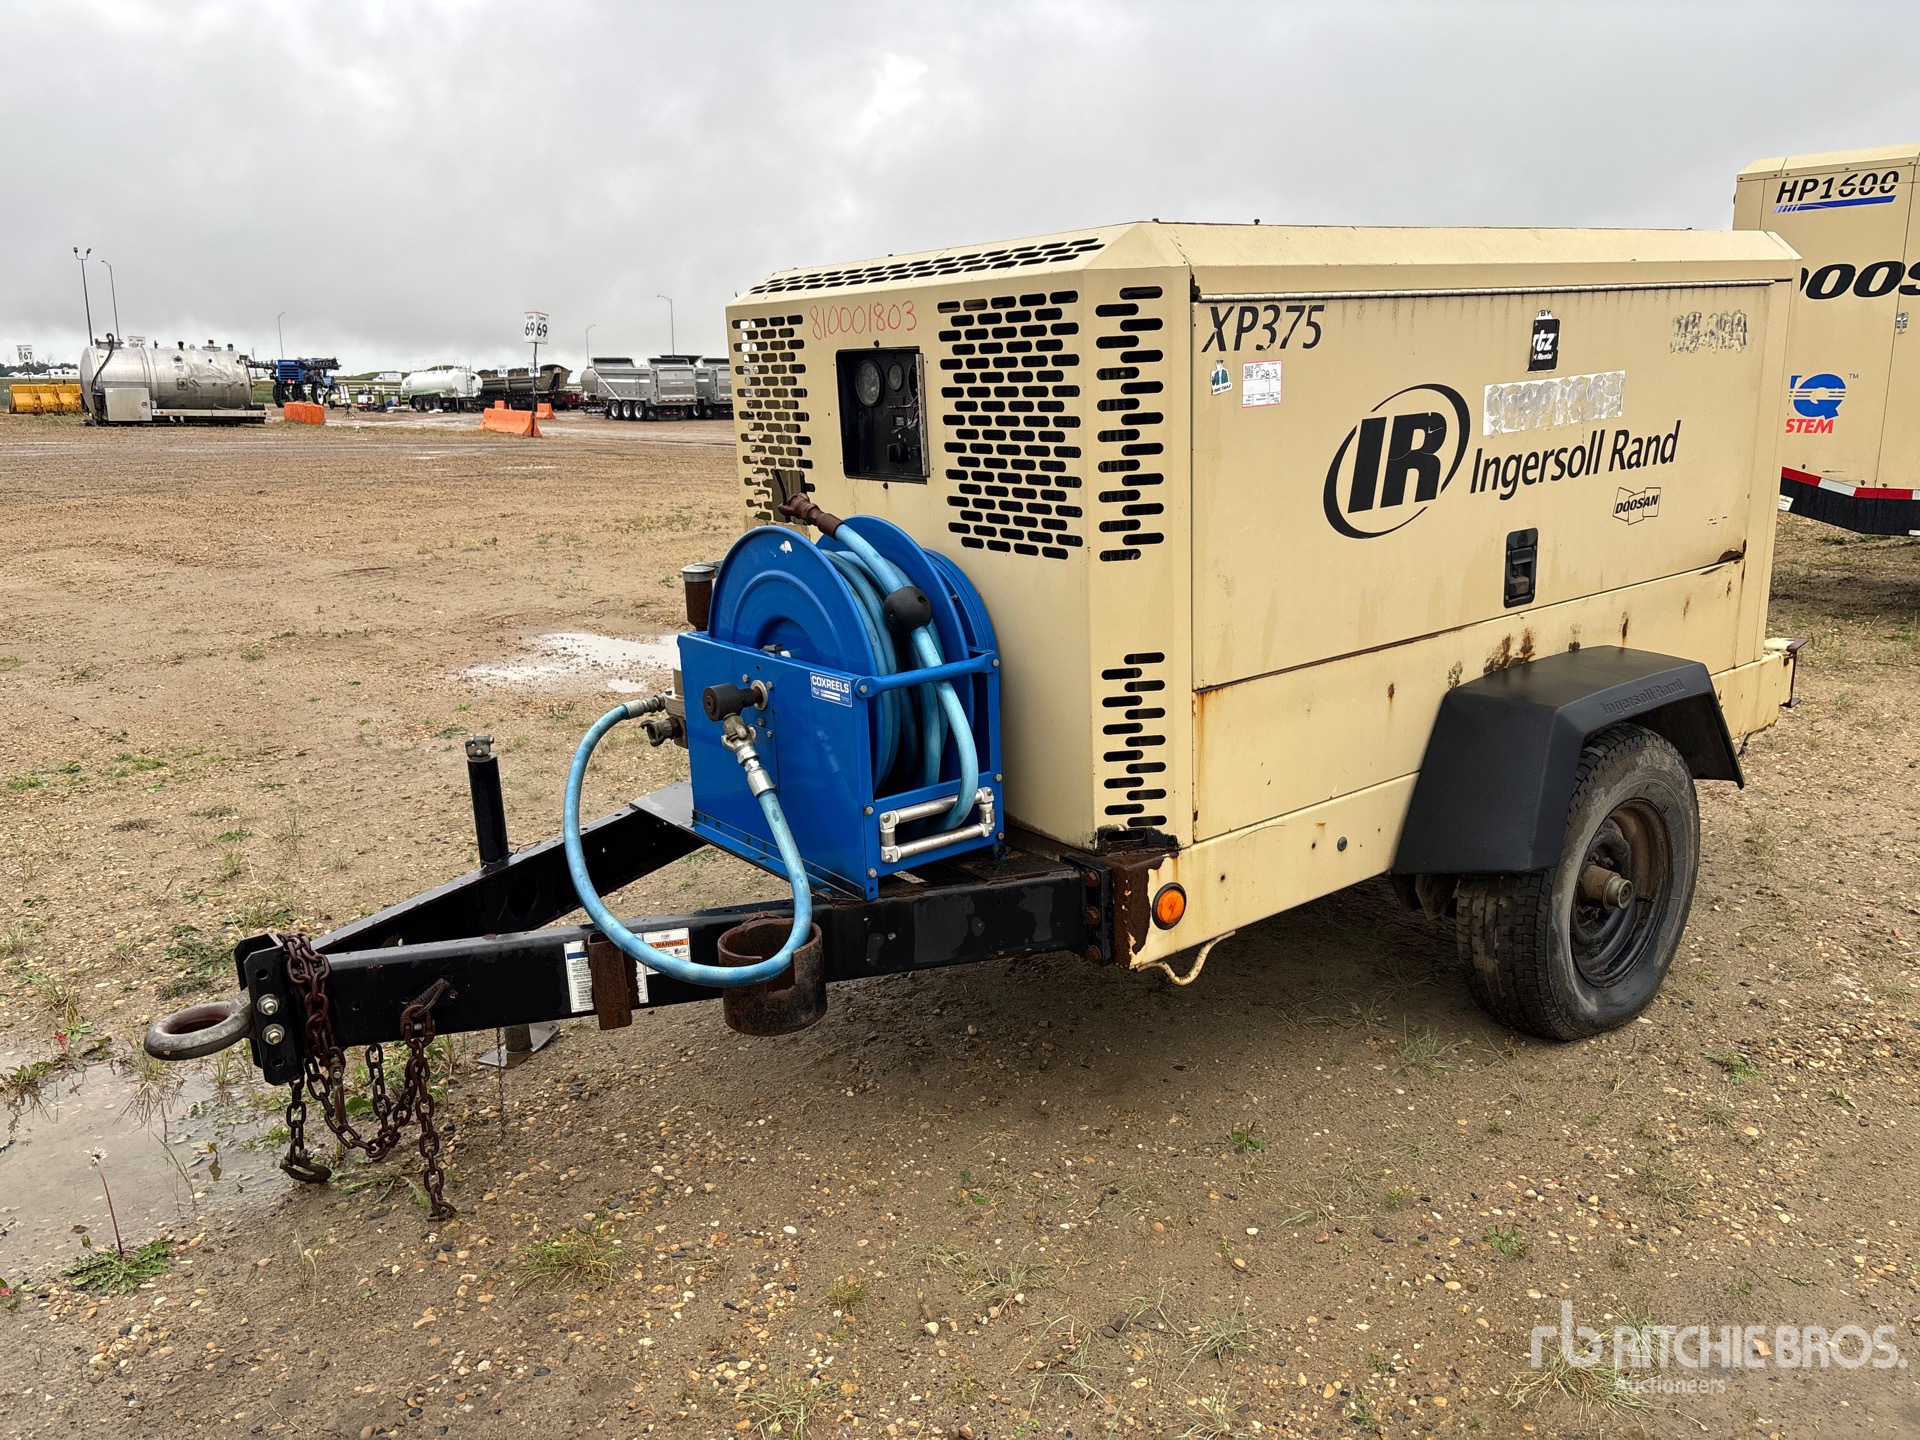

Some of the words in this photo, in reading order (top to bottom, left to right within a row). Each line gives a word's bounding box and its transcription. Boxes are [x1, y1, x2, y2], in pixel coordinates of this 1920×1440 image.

[1776, 171, 1900, 203] HP1600
[1800, 260, 1920, 300] OOS
[525, 321, 535, 336] 69
[536, 323, 547, 338] 69
[809, 300, 917, 340] 810001803
[1201, 304, 1325, 353] XP375
[1347, 411, 1447, 514] IR
[1470, 429, 1606, 501] Ingersoll
[1608, 420, 1681, 472] Rand
[1615, 494, 1659, 514] DOOSAN
[811, 676, 849, 693] COXREELS
[656, 939, 684, 948] WARNING
